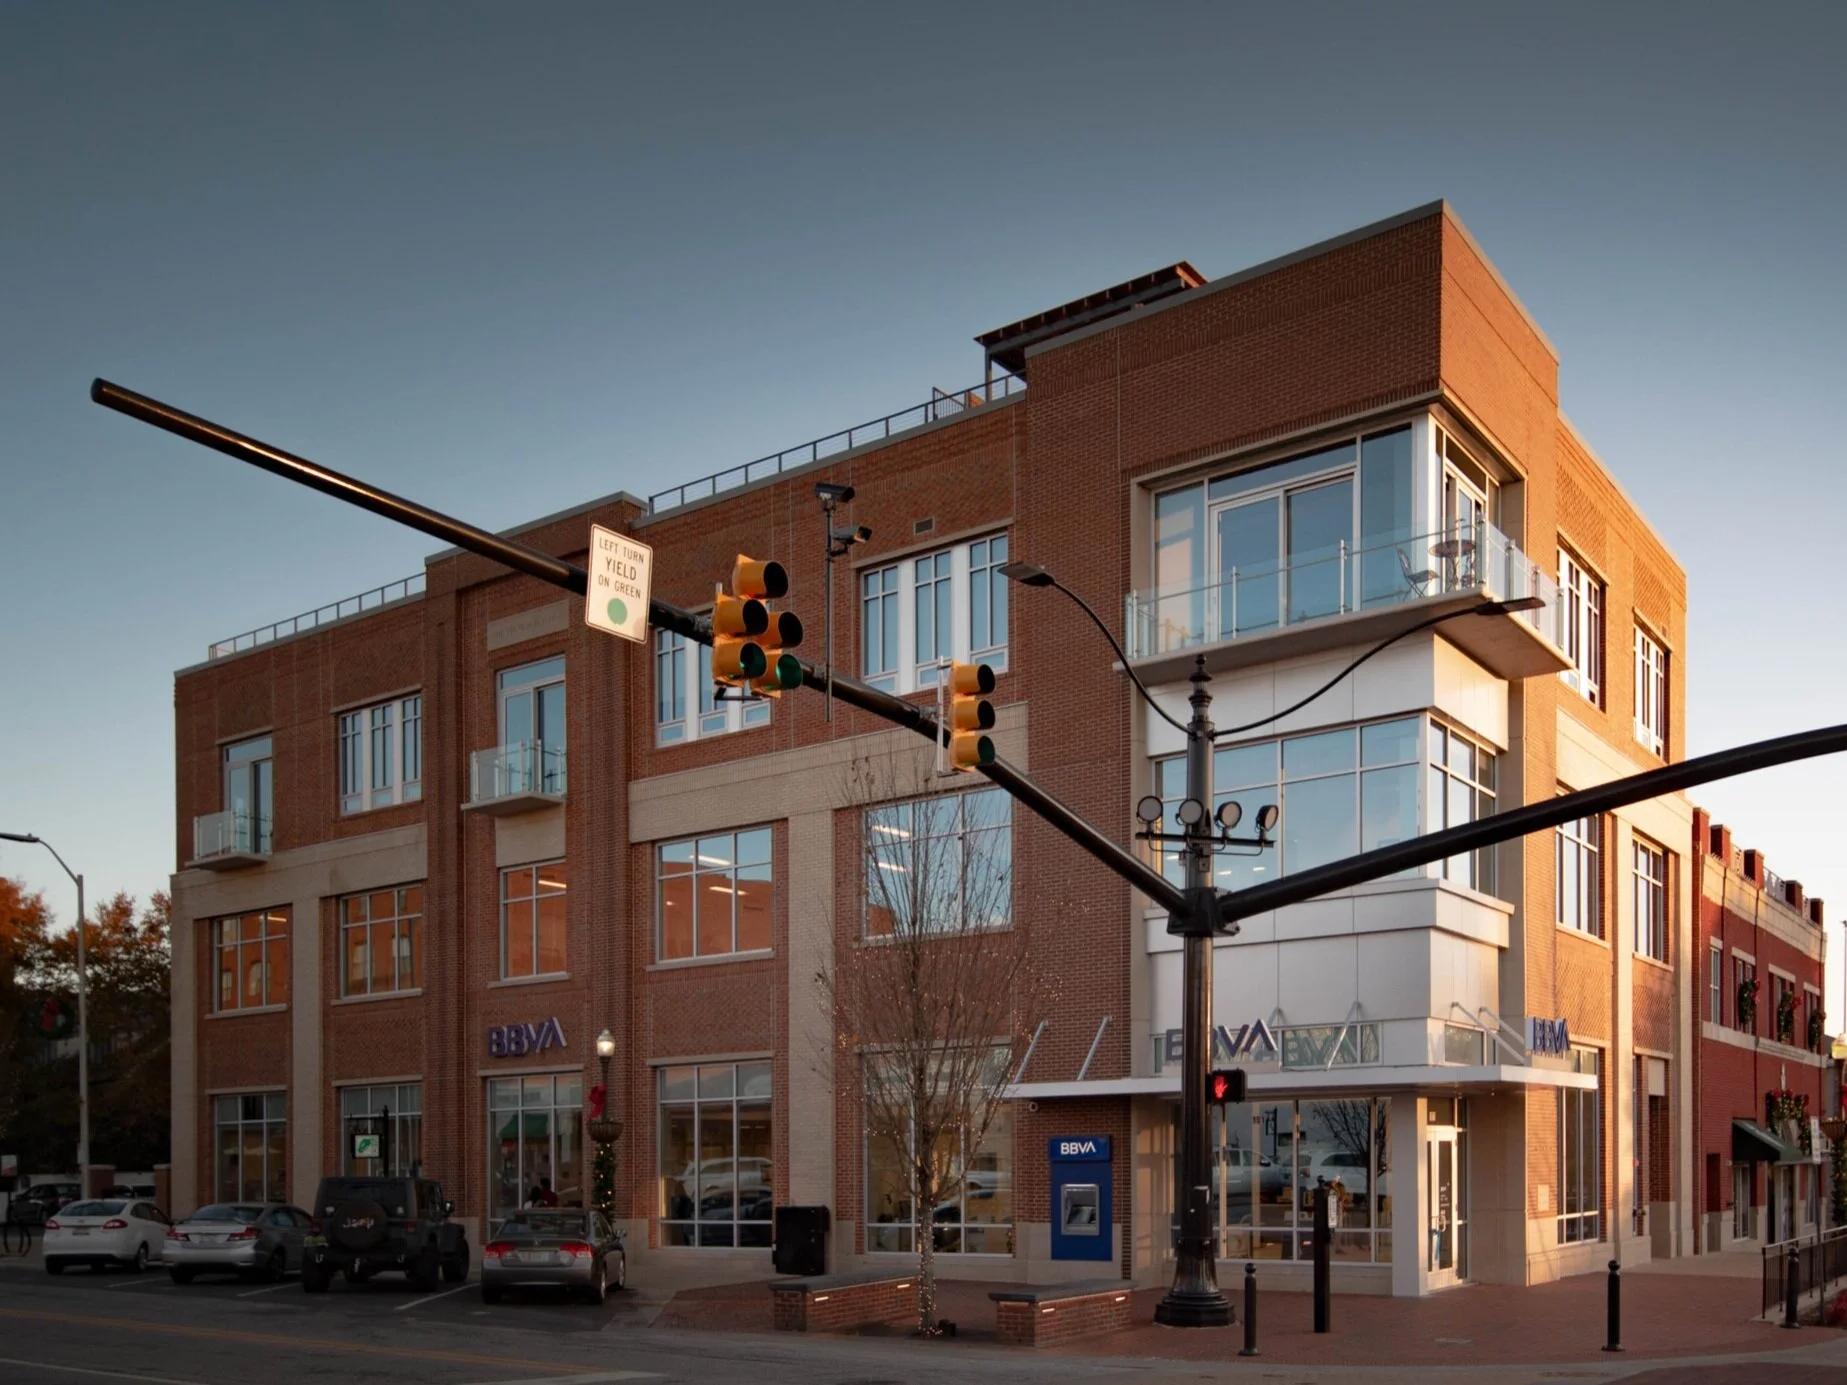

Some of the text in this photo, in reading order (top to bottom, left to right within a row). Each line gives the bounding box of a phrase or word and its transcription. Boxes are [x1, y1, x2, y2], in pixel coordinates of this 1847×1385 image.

[599, 537, 644, 563] LEFT TURN
[606, 556, 637, 581] YIELD
[598, 574, 642, 599] ON GREEN
[488, 1016, 568, 1057] BBVA
[1166, 1018, 1279, 1061] BVA
[1532, 1016, 1570, 1054] BBVA
[1060, 1141, 1096, 1155] BBVA
